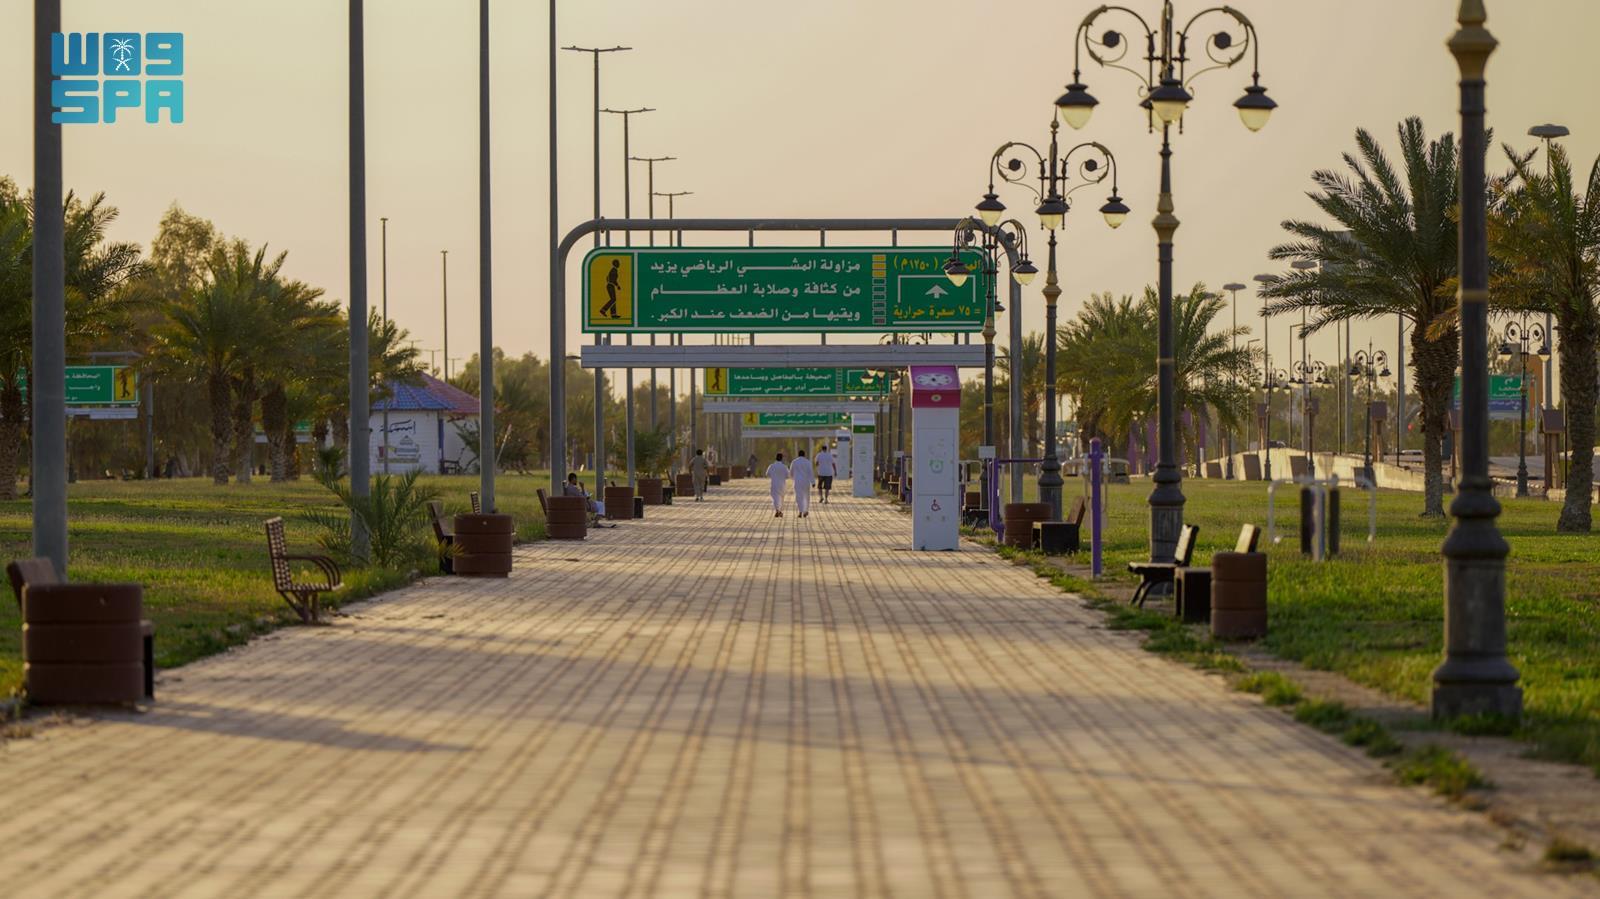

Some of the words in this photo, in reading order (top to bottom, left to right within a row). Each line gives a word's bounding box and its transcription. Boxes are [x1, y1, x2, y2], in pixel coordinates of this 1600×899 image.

[650, 261, 678, 274] يزيد
[680, 259, 733, 277] الرياضي
[737, 258, 816, 277] المشي
[820, 259, 861, 273] مزاولة
[650, 283, 748, 300] العظام
[752, 282, 799, 298] وصلابة
[804, 281, 838, 295] كثافة
[843, 285, 861, 297] من
[690, 308, 726, 319] عند
[729, 307, 778, 319] الضعف
[781, 310, 809, 321] من
[813, 307, 861, 322] ويقيها
[893, 305, 925, 319] حرارية
[929, 305, 955, 319] سعرة
[958, 305, 971, 316] ٧٥
